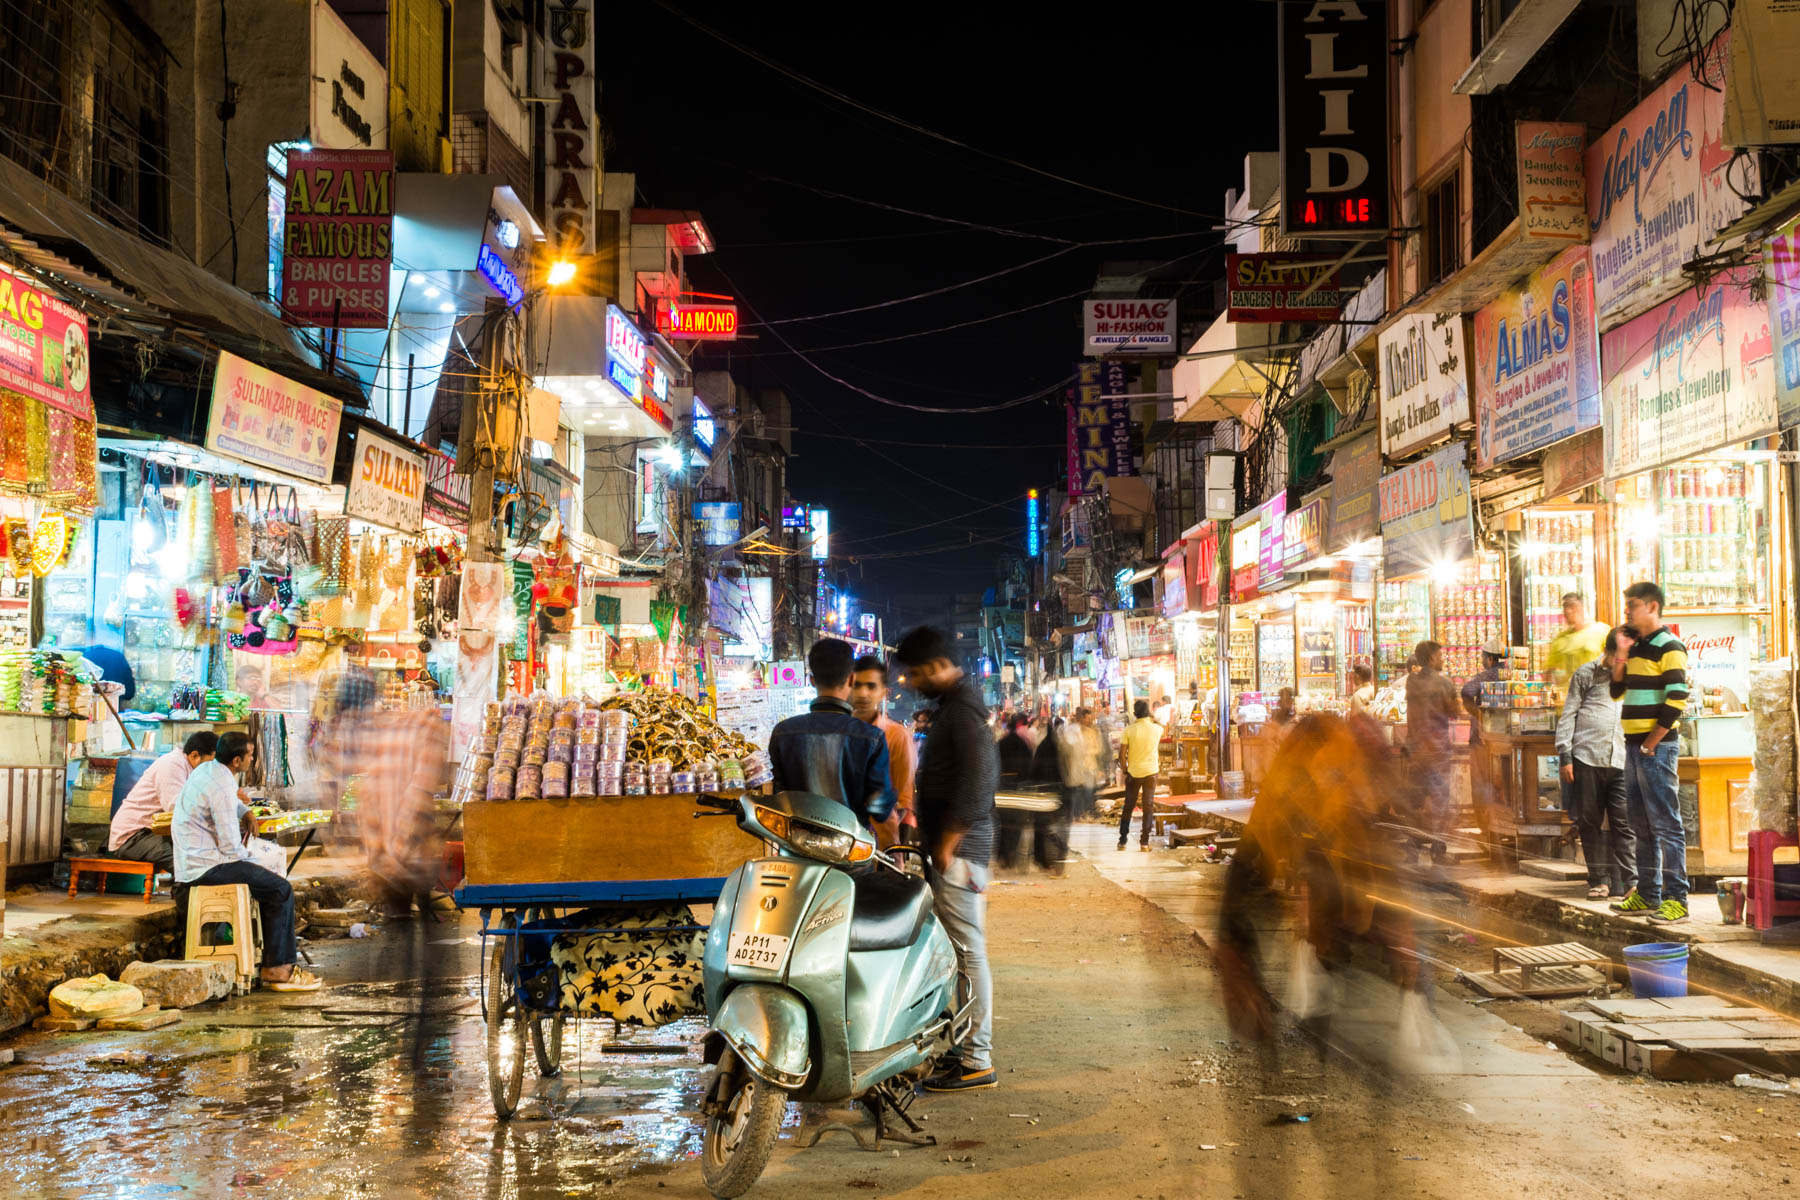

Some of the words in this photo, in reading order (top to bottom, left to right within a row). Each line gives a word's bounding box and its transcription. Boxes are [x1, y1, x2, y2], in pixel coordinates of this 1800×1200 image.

[552, 52, 588, 249] PARAS
[1523, 131, 1582, 158] Nayeem
[1591, 83, 1693, 233] Nayeem
[1525, 160, 1569, 173] Bangles
[1526, 174, 1580, 188] Jewellery
[286, 168, 392, 216] AZAM
[286, 222, 391, 259] FAMOUS
[1595, 233, 1633, 285] Bangles
[1643, 191, 1695, 251] Jewellery
[291, 262, 382, 282] BANGLES
[1239, 259, 1332, 285] SAPNA
[286, 287, 299, 307] &
[308, 288, 384, 307] PURSES
[1094, 303, 1168, 319] SUHAG
[1231, 291, 1271, 308] BANGLES
[1275, 291, 1283, 308] &
[1287, 291, 1338, 308] JEWELLERS
[0, 320, 35, 346] TORE
[671, 311, 734, 331] DIAMOND
[1097, 322, 1164, 332] HI-FASHION
[1495, 279, 1570, 385] ALMAS
[1643, 285, 1724, 383] Nayeem
[1385, 320, 1428, 401] Khalid
[234, 376, 272, 411] SULTAN
[271, 391, 295, 418] ZARI
[296, 401, 329, 430] PALACE
[1495, 383, 1523, 410] Bangles
[1525, 378, 1531, 395] &
[1532, 359, 1570, 392] Jewellery
[1640, 391, 1673, 422] Bangles
[1685, 367, 1731, 405] Jewellery
[1077, 364, 1110, 491] FEMINA
[362, 444, 421, 500] SULTAN
[1379, 459, 1438, 524] KHALID
[1284, 504, 1319, 547] SAPNA
[810, 813, 842, 828] HONDA
[735, 948, 778, 964] AD2737
[744, 935, 770, 948] AP11
